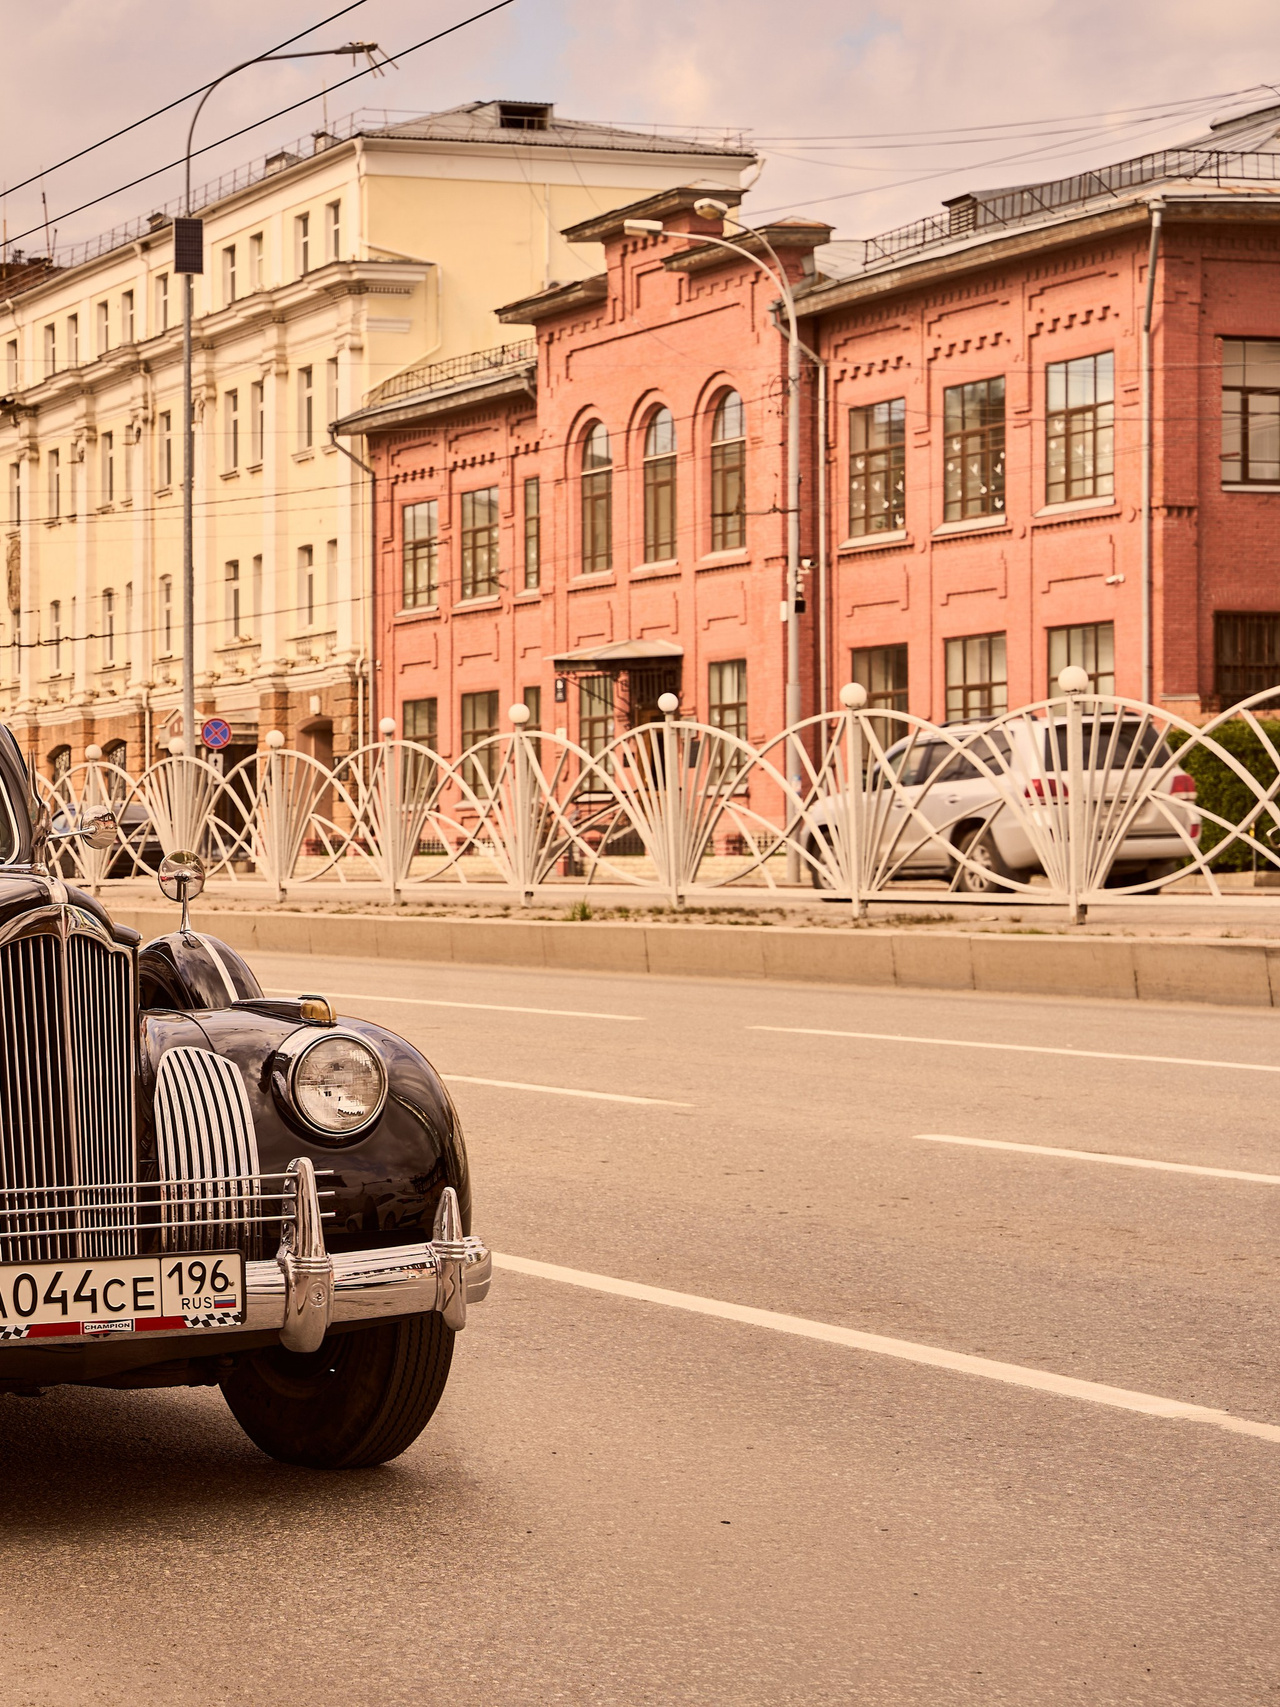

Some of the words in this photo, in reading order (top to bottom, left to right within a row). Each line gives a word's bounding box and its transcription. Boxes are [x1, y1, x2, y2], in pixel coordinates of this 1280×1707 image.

[167, 1259, 230, 1296] 196
[181, 1297, 213, 1310] RUS
[84, 1322, 131, 1330] CHAMPION
